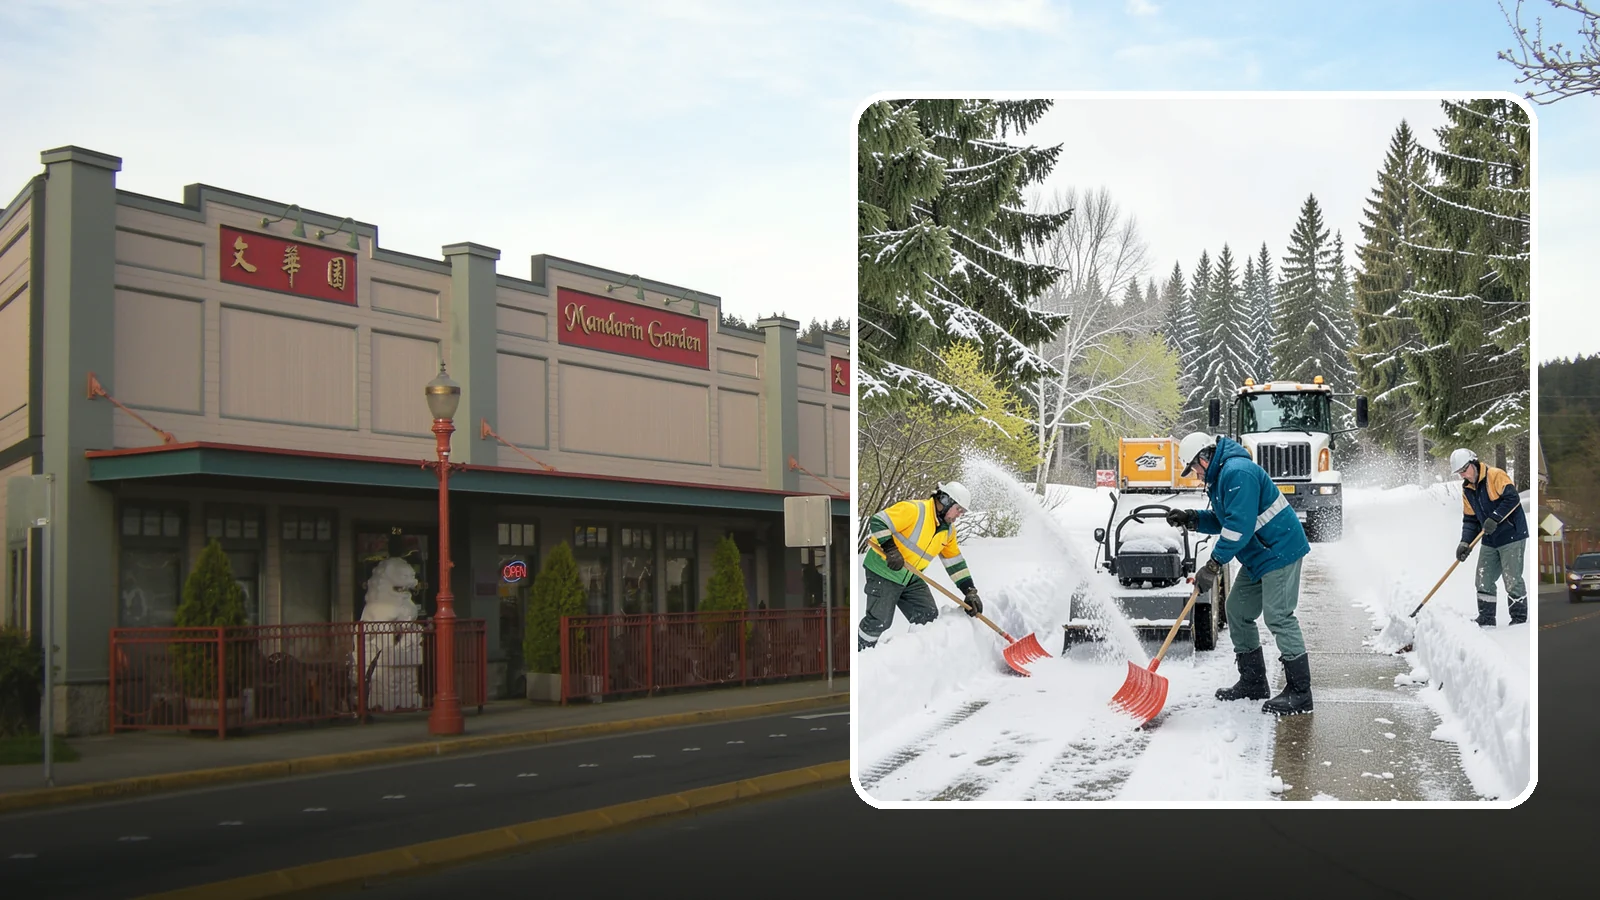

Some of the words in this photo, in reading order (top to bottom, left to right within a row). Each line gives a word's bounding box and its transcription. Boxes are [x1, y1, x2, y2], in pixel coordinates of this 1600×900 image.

[230, 235, 347, 291] 文華園
[564, 302, 645, 341] Mandarin
[648, 320, 702, 352] Garden
[503, 565, 527, 578] OPEN
